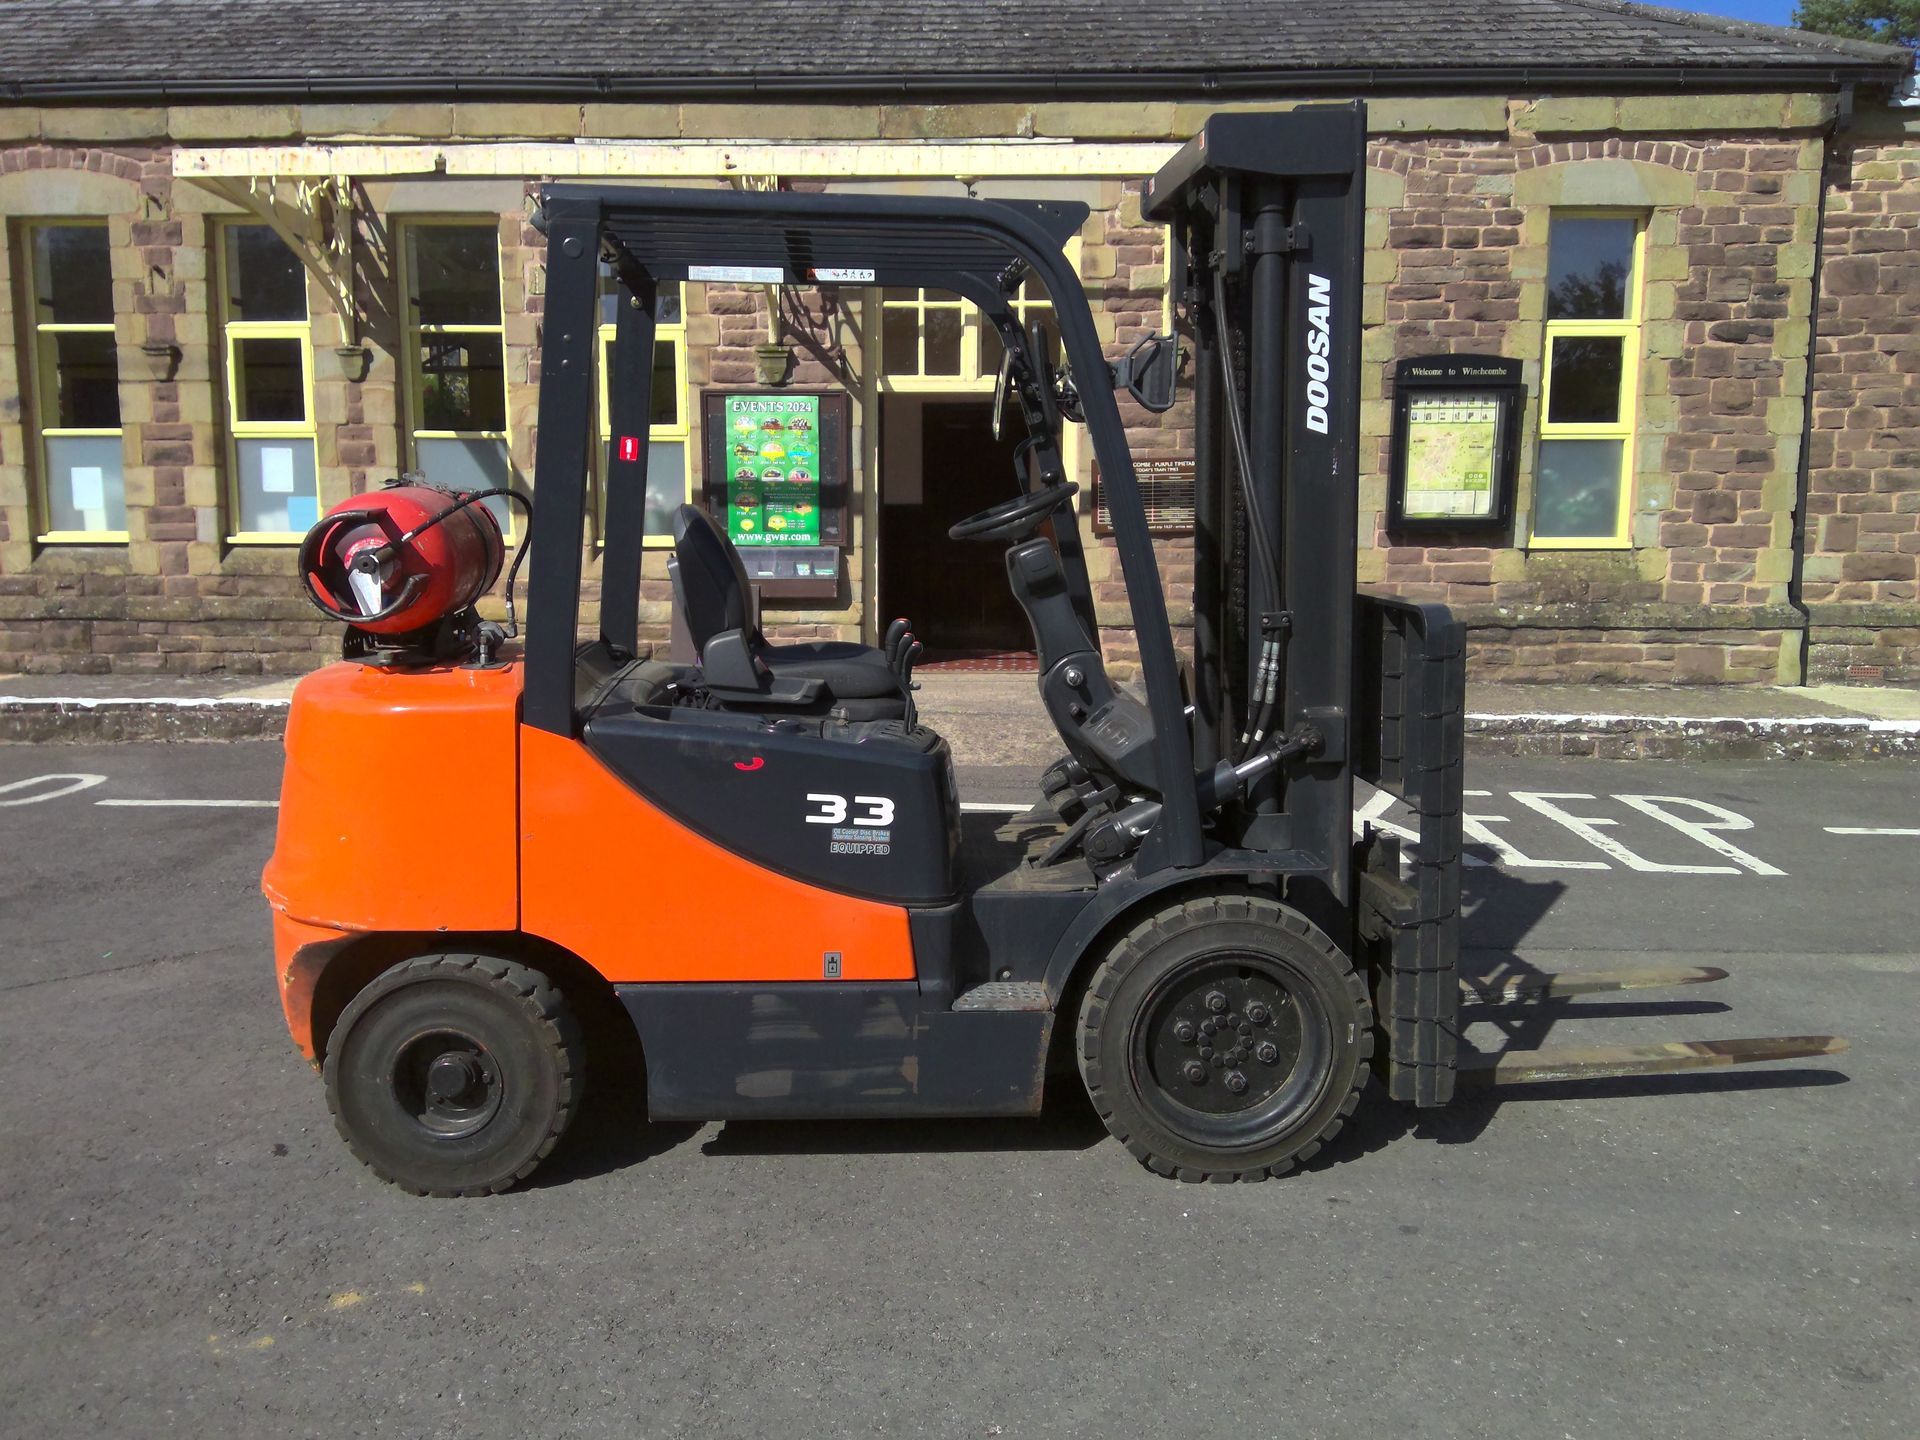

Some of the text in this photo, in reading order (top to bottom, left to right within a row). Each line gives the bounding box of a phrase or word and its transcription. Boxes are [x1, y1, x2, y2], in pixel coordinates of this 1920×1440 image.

[1306, 273, 1331, 435] DOOSAN
[1411, 367, 1507, 376] Welcome to Winchcombe
[733, 401, 812, 412] EVENTS 2024
[737, 533, 811, 544] www.gwsr.com
[805, 793, 895, 827] 33
[830, 842, 890, 855] EQUIPPED
